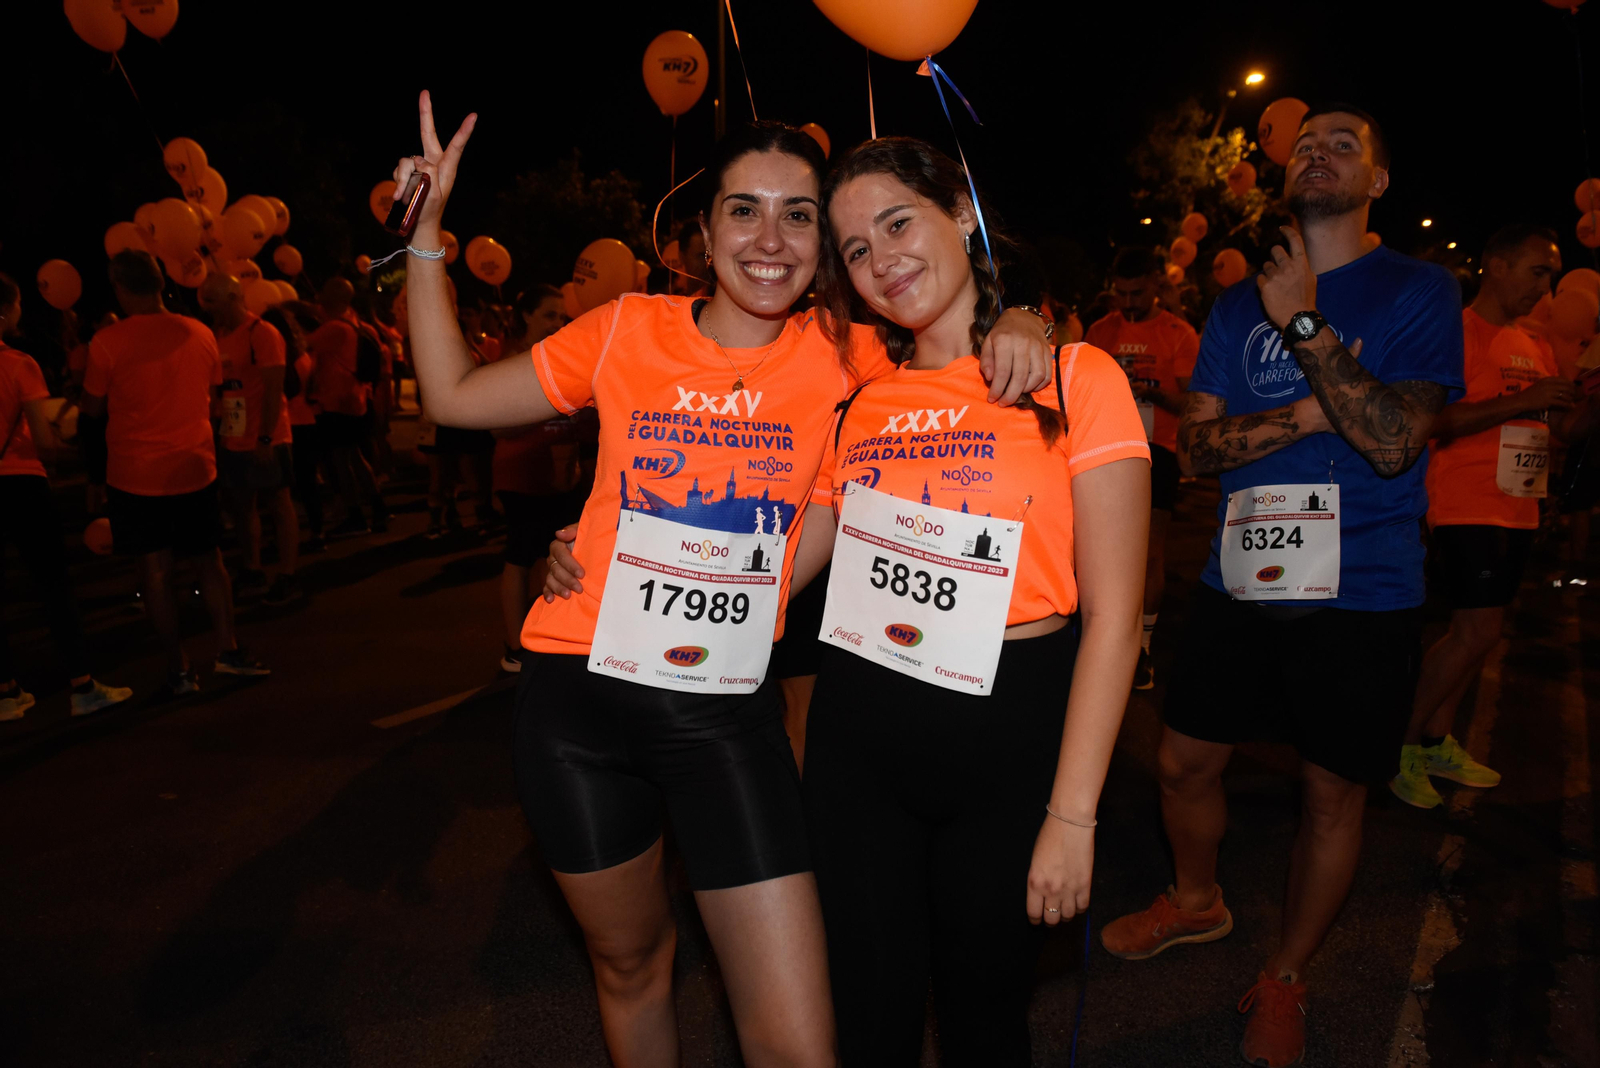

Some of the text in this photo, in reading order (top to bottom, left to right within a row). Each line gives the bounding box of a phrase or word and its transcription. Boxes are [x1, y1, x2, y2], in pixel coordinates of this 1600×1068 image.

[1118, 344, 1148, 353] XXXV
[672, 386, 762, 418] XXXV
[631, 410, 794, 434] CARRERA NOCTURNA
[879, 405, 970, 435] XXXV
[628, 422, 794, 451] DEL GUADALQUIVIR
[848, 430, 997, 453] CARRERA NOCTURNA
[848, 444, 994, 465] GUADALQUIVIR
[1514, 452, 1548, 468] 12723
[845, 527, 858, 536] XXXV
[859, 532, 882, 544] CARRERA
[882, 541, 912, 554] NOCTURNA
[913, 550, 924, 558] DEL
[925, 553, 972, 569] GUADALQUIVIR
[1242, 526, 1304, 551] 6324
[621, 555, 637, 564] XXXV
[637, 560, 663, 571] CARRERA
[664, 566, 699, 578] NOCTURNA
[700, 572, 710, 580] DEL
[712, 575, 750, 583] GUADALQUIVIR
[870, 556, 958, 611] 5838
[639, 579, 750, 624] 17989
[719, 676, 759, 685] Cruzcampo
[935, 666, 983, 685] Cruzcampo
